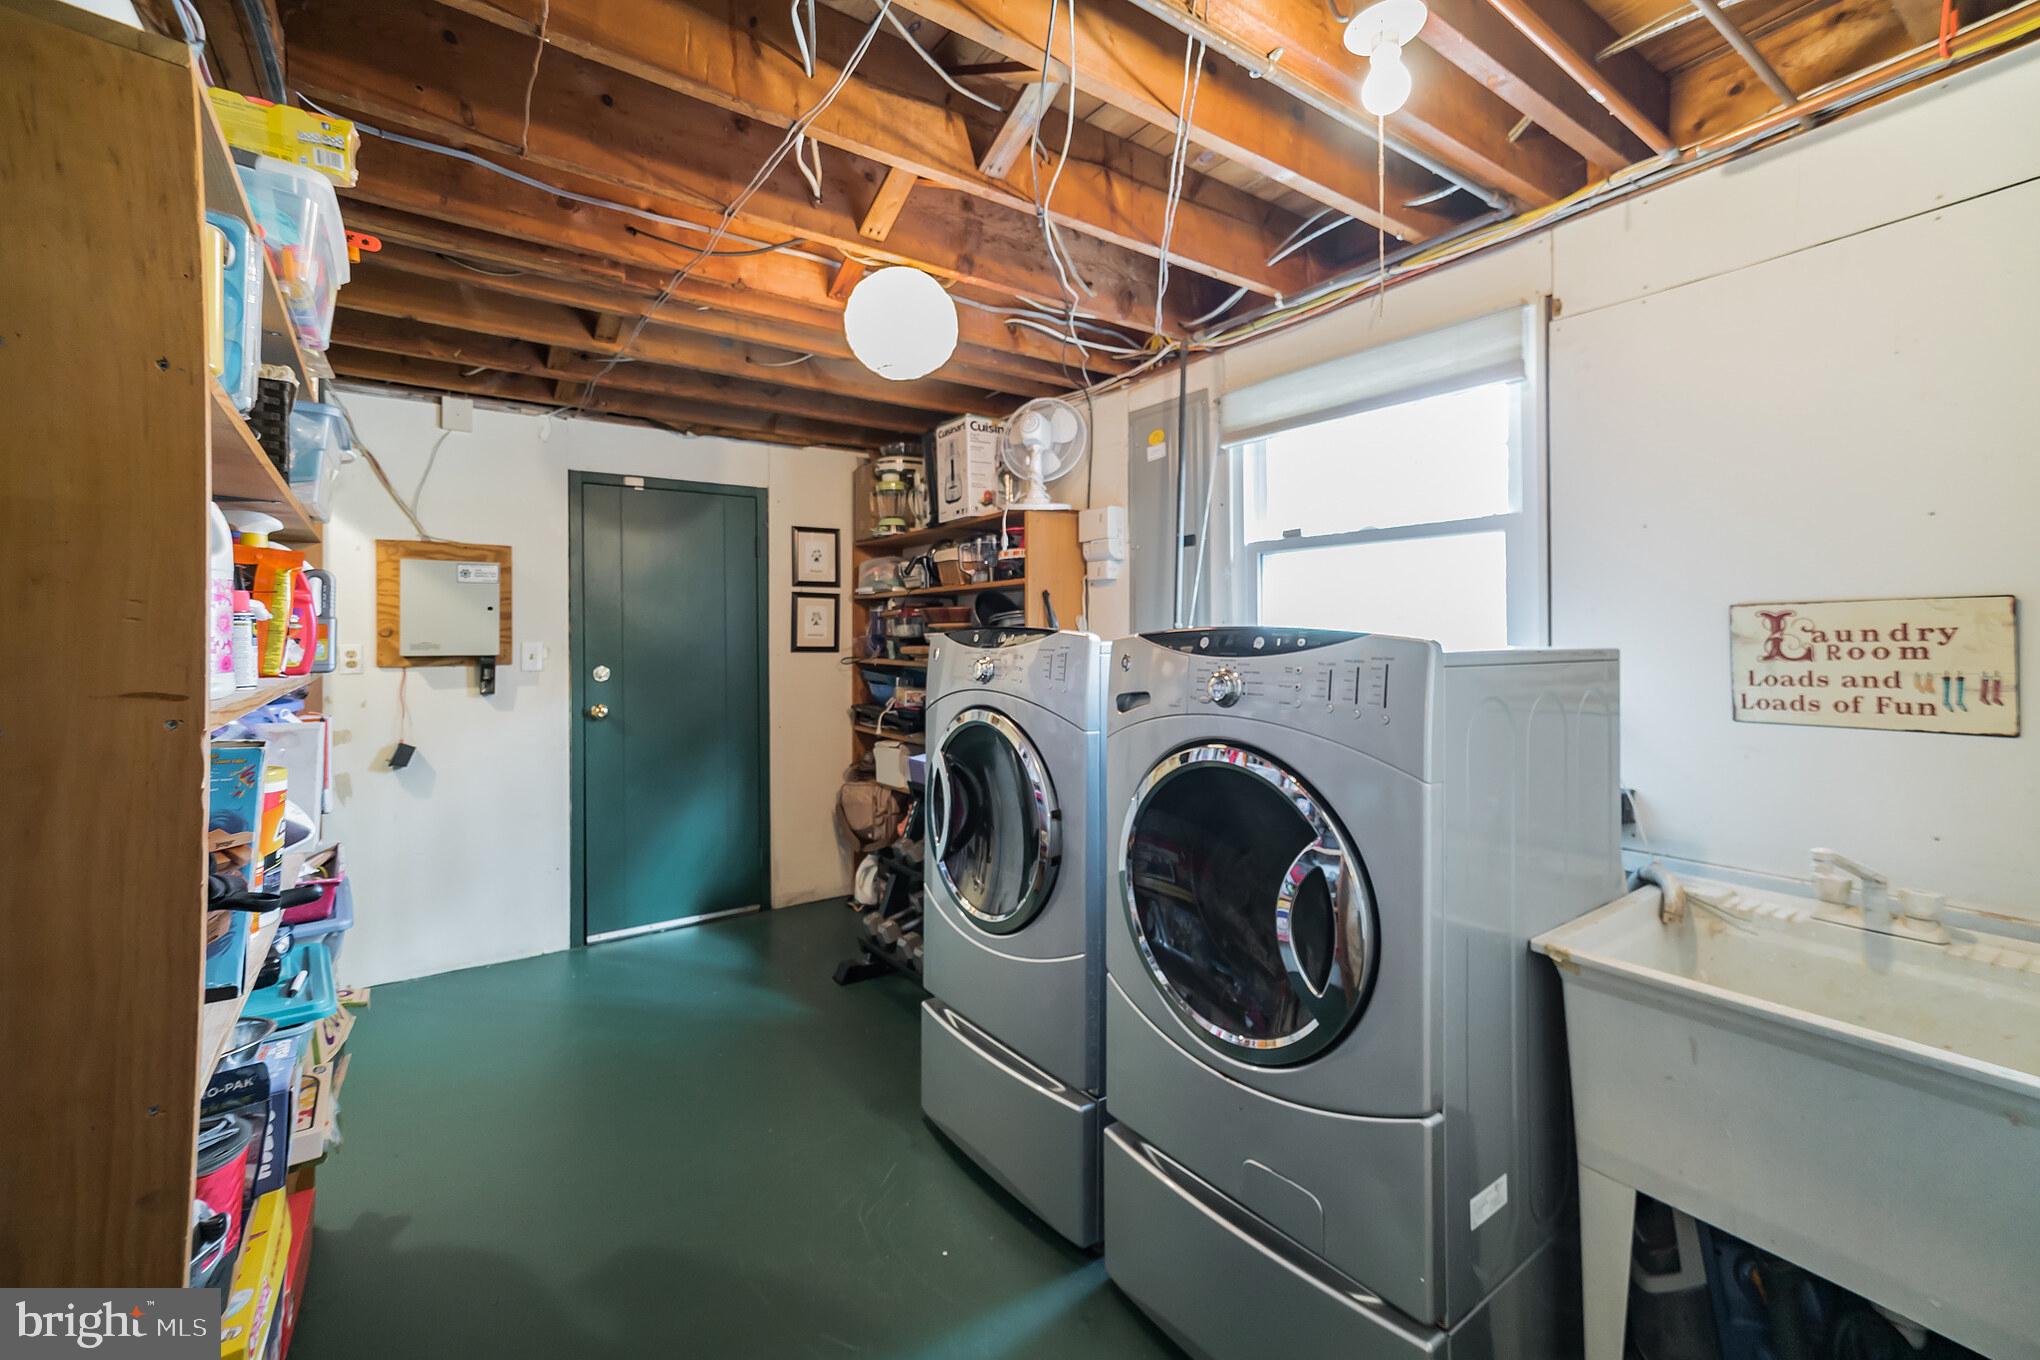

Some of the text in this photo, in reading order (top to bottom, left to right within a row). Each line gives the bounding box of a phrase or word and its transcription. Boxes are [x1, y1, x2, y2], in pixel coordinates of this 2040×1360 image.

[1755, 610, 1959, 662] Laundry
[1748, 670, 1903, 689] Loads and
[1741, 693, 1938, 716] Loads of Fun
[202, 1076, 254, 1099] O-PAK
